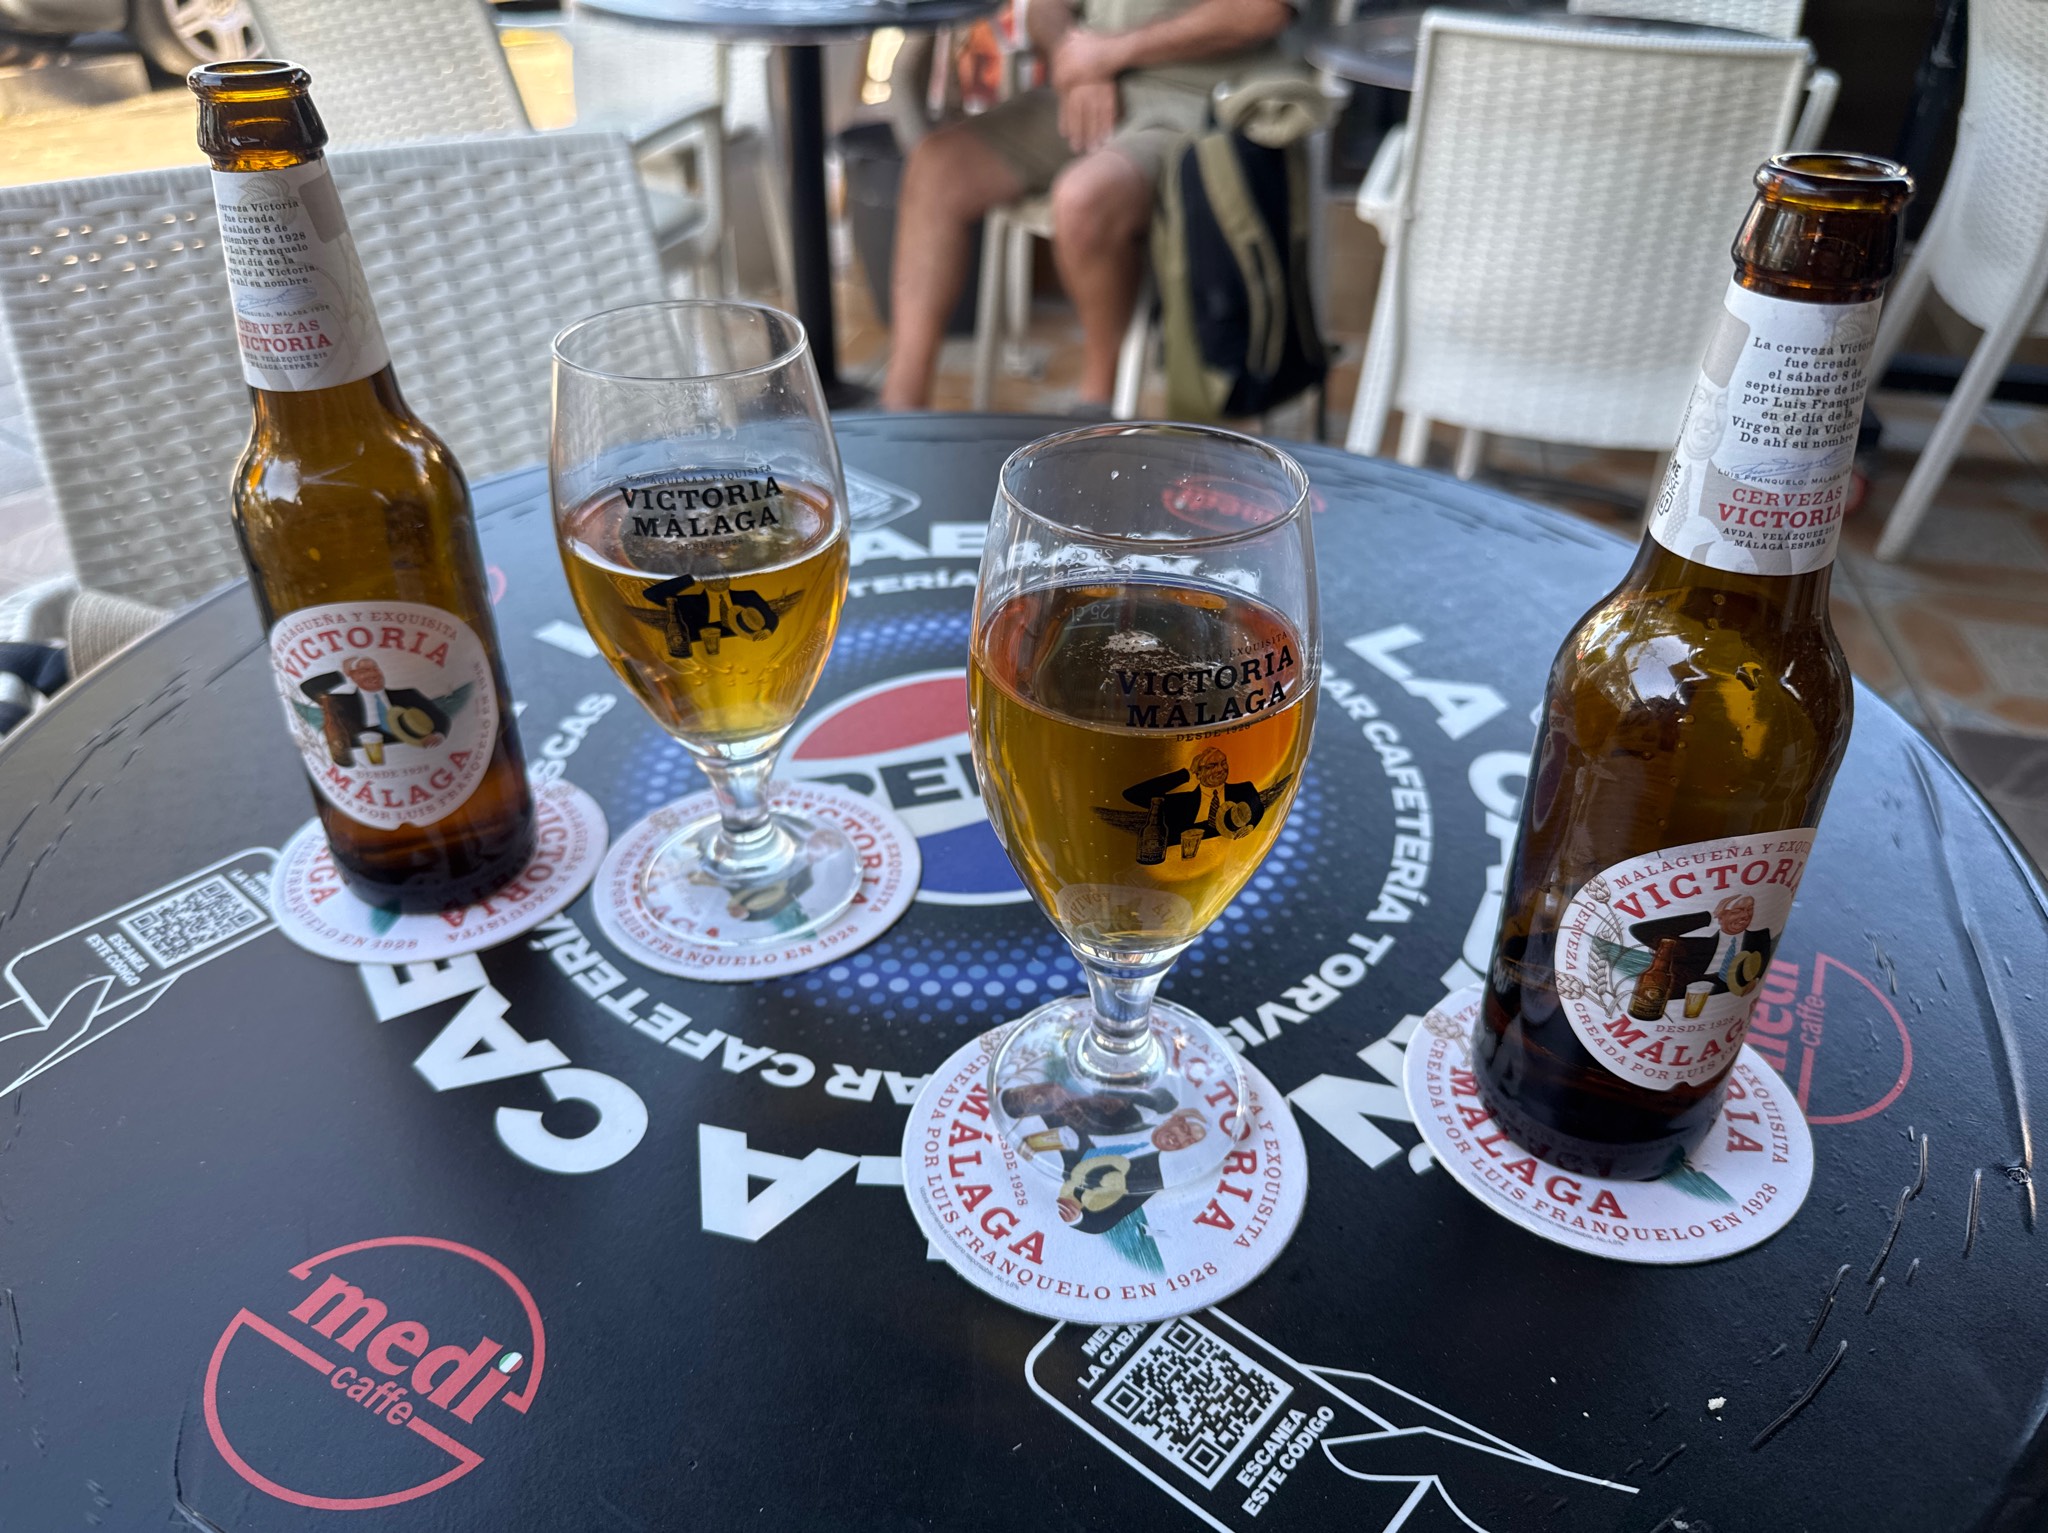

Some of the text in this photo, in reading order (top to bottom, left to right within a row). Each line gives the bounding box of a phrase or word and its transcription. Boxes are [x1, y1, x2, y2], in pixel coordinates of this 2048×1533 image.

[238, 214, 275, 223] creada
[251, 200, 299, 212] Victoria
[262, 232, 306, 245] de 1928
[264, 225, 271, 233] 8
[274, 224, 288, 232] de
[249, 244, 309, 257] Franquelo
[267, 256, 281, 266] de
[284, 256, 295, 265] la
[239, 319, 320, 335] CERVEZAS
[1753, 337, 1834, 355] La cerveza
[1768, 370, 1782, 380] el
[1786, 371, 1838, 383] sábado
[1841, 370, 1849, 381] 8
[1784, 357, 1857, 369] fue creada
[1742, 393, 1806, 408] por Luis
[1745, 380, 1848, 396] septiembre de
[1732, 416, 1819, 435] Virgen de la
[1761, 409, 1853, 422] en el día de la
[1740, 432, 1808, 448] De ahí su
[711, 464, 772, 483] EXQUISITA
[1718, 468, 1739, 479] LUIS
[620, 476, 783, 511] VICTORIA
[1732, 487, 1843, 507] CERVEZAS
[632, 506, 779, 538] MÁLAGA
[1718, 501, 1841, 529] VICTORIA
[1723, 527, 1823, 541] AVDA. VELÁZQUEZ
[1734, 538, 1826, 550] MÁLAGA-ESPAÑA
[353, 612, 363, 622] Y
[370, 611, 457, 641] EXQUISITA
[283, 626, 452, 680] VICTORIA
[1116, 645, 1294, 697] VICTORIA
[1343, 622, 1510, 742] LA
[1176, 722, 1252, 743] DESDE 1928
[325, 750, 472, 808] MÁLAGA
[396, 806, 436, 822] LUIS
[1362, 718, 1436, 925] CAFETERÍA
[1613, 843, 1754, 889] MALAGUEÑA
[1761, 843, 1773, 854] Y
[84, 932, 109, 959] ESTE
[647, 936, 778, 967] FRANQUELO
[784, 944, 814, 960] EN
[818, 924, 860, 949] 1928
[1566, 901, 1597, 972] CERVEZA
[106, 931, 150, 974] ESCANEA
[530, 911, 817, 1090] CAFETERÍA
[1655, 1023, 1706, 1034] DESDE
[1795, 993, 1826, 1049] caffe
[1574, 1003, 1716, 1081] CREADA POR LUIS
[1736, 1062, 1789, 1165] EXQUISITA
[1425, 1038, 1448, 1110] CREADA
[1437, 1114, 1473, 1156] POR
[1472, 1158, 1526, 1201] LUIS
[1531, 1197, 1706, 1242] FRANQUELO
[1708, 1214, 1743, 1235] EN
[1744, 1182, 1779, 1218] 1928
[924, 1054, 1219, 1301] CREADA POR LUIS FRANQUELO EN 1928
[947, 1082, 1046, 1266] MÁLAGA
[1233, 1120, 1282, 1249] Y EXQUISITA
[1009, 1172, 1028, 1207] 1928
[287, 1272, 525, 1426] medi
[1077, 1365, 1104, 1391] LA
[330, 1365, 415, 1427] caffe
[1235, 1408, 1307, 1490] ESCANEA
[1241, 1404, 1336, 1518] ESTE CÓDIGO
